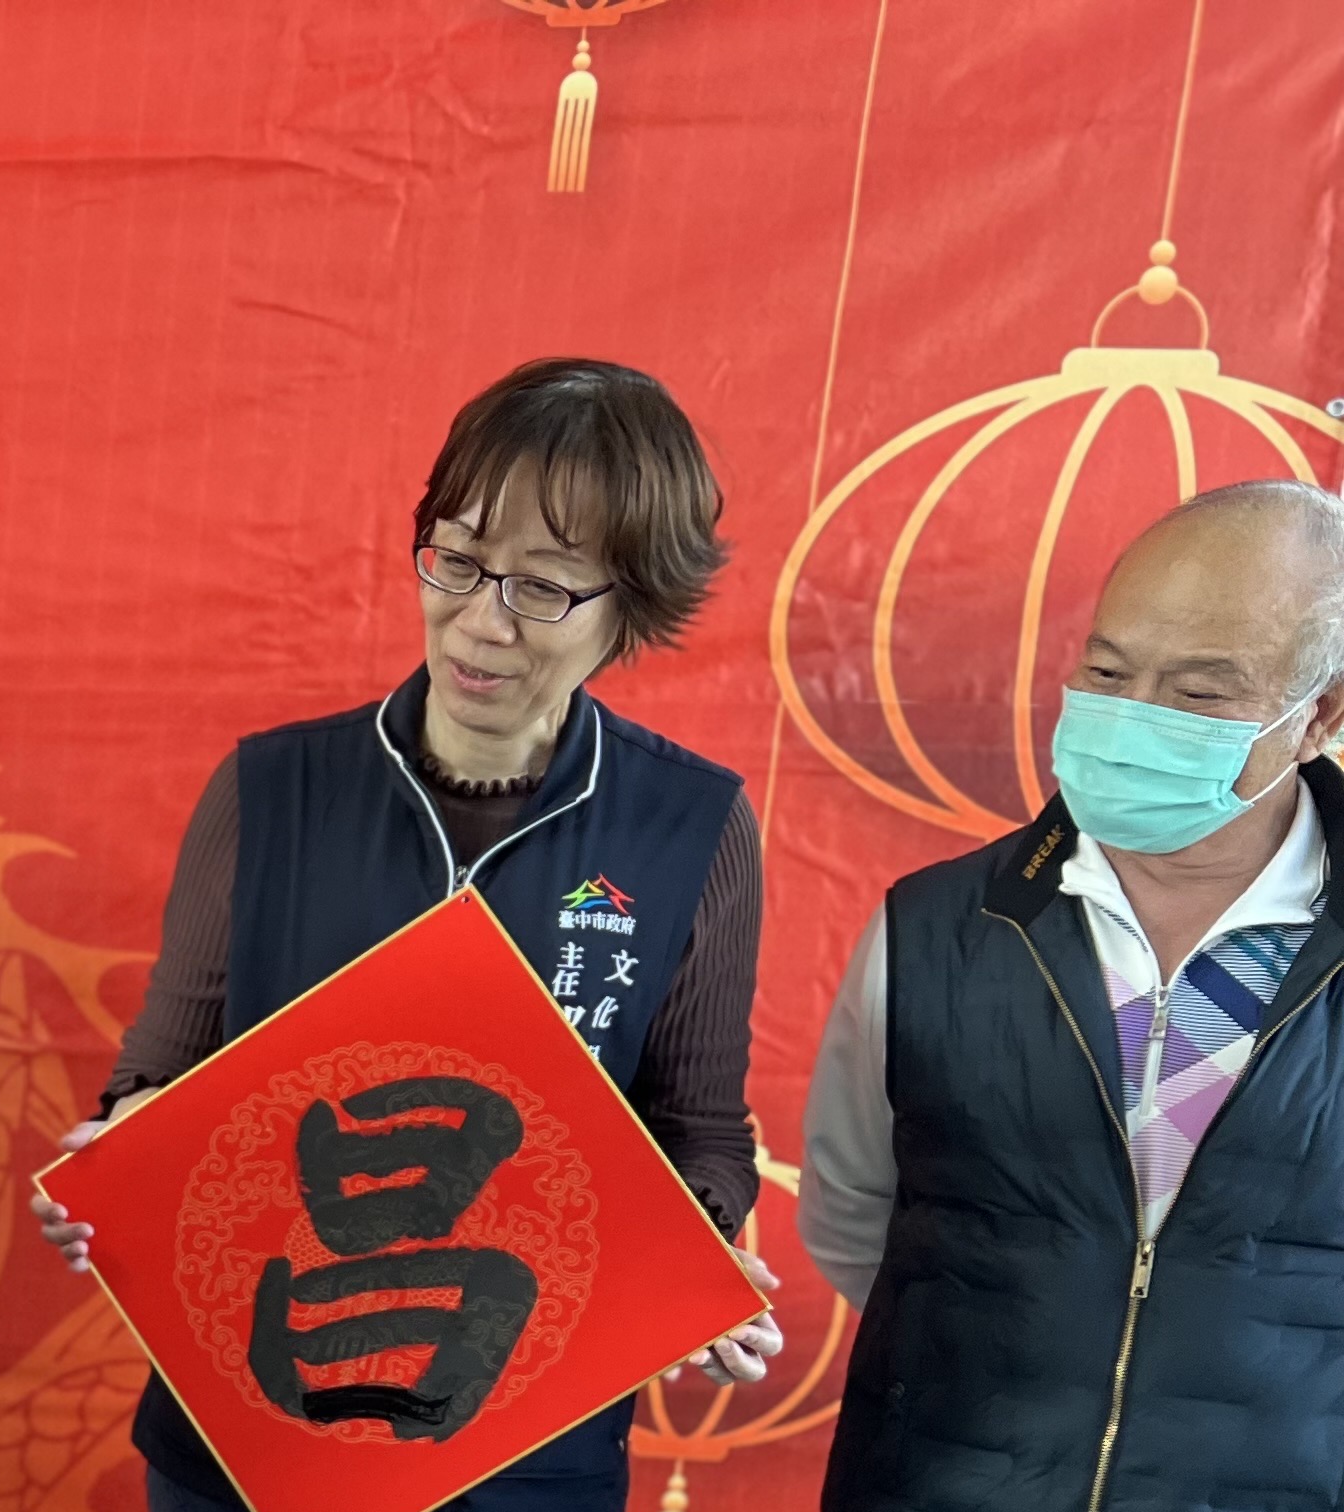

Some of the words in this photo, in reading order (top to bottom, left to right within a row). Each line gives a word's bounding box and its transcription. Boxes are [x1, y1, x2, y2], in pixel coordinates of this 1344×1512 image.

[559, 910, 636, 936] 臺中市政府
[248, 1075, 539, 1443] 昌
